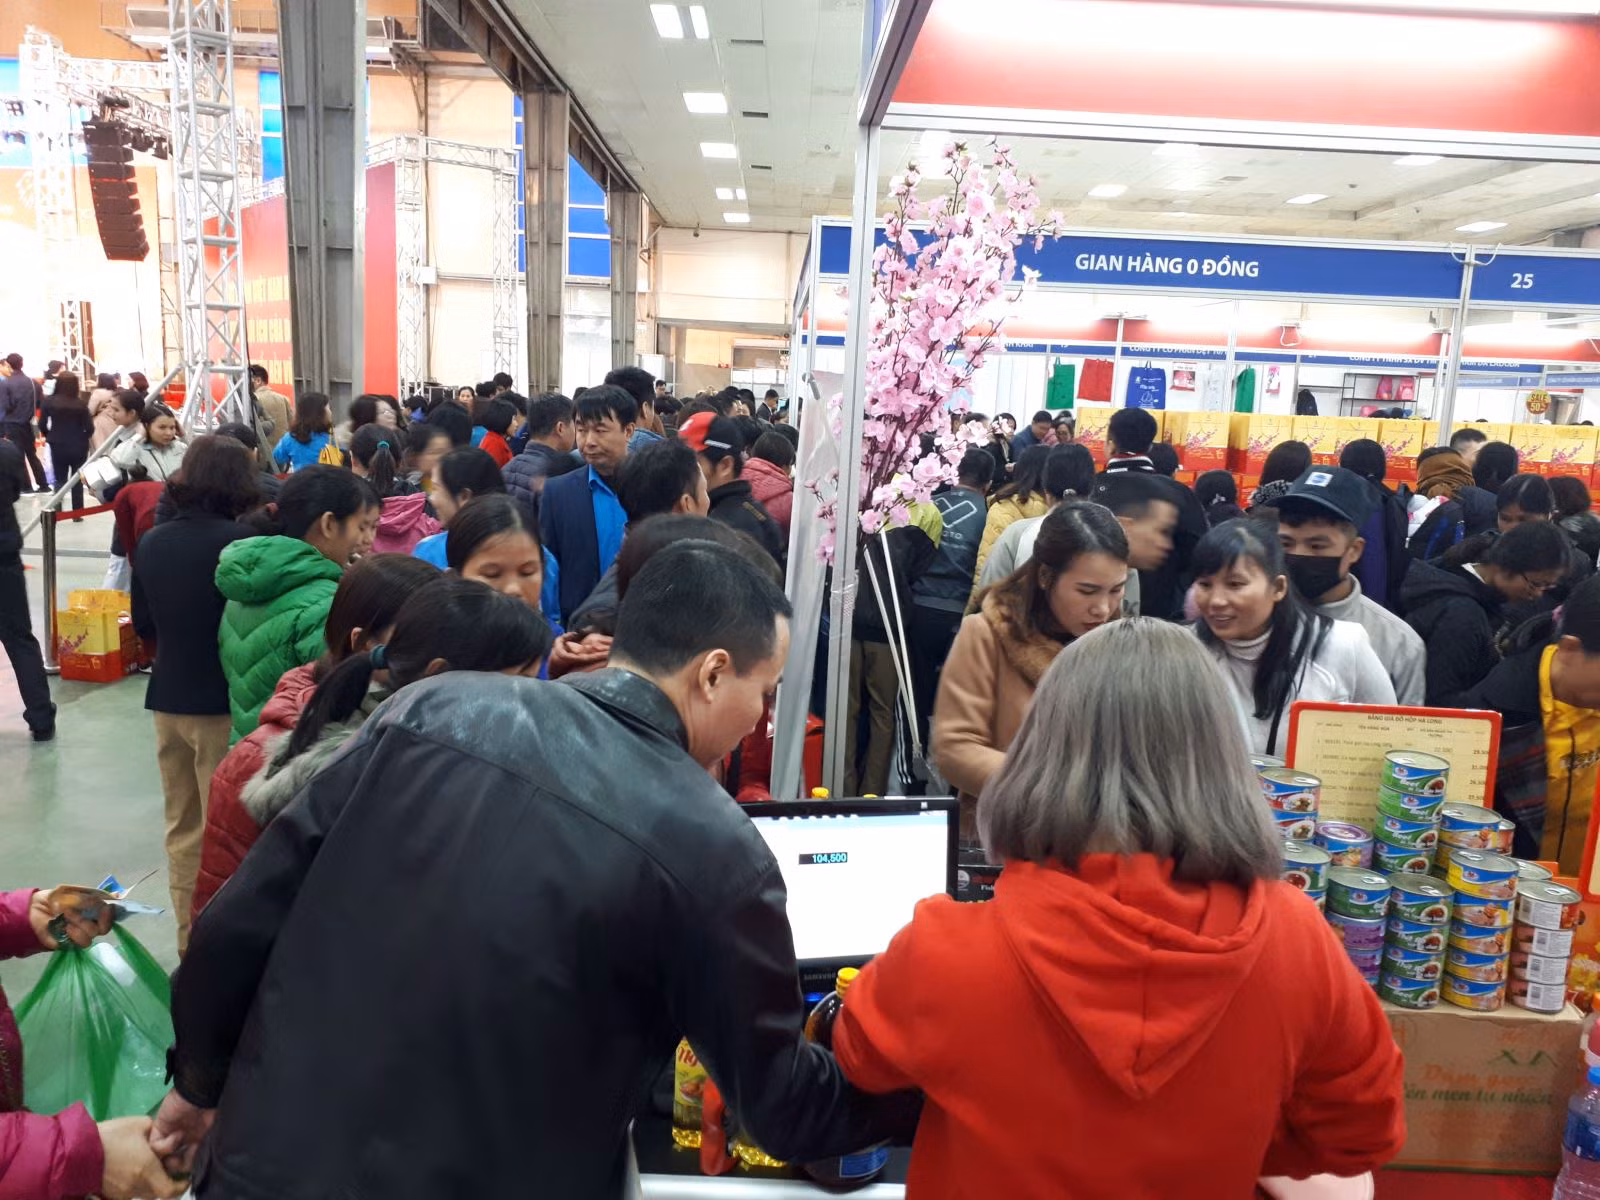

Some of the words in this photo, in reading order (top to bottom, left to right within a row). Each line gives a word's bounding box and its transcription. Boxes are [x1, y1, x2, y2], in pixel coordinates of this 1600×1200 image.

[1075, 253, 1123, 272] GIAN
[1127, 252, 1183, 274] HÀNG
[1186, 258, 1199, 275] 0
[1202, 254, 1259, 278] ĐỒNG
[1510, 272, 1534, 289] 25
